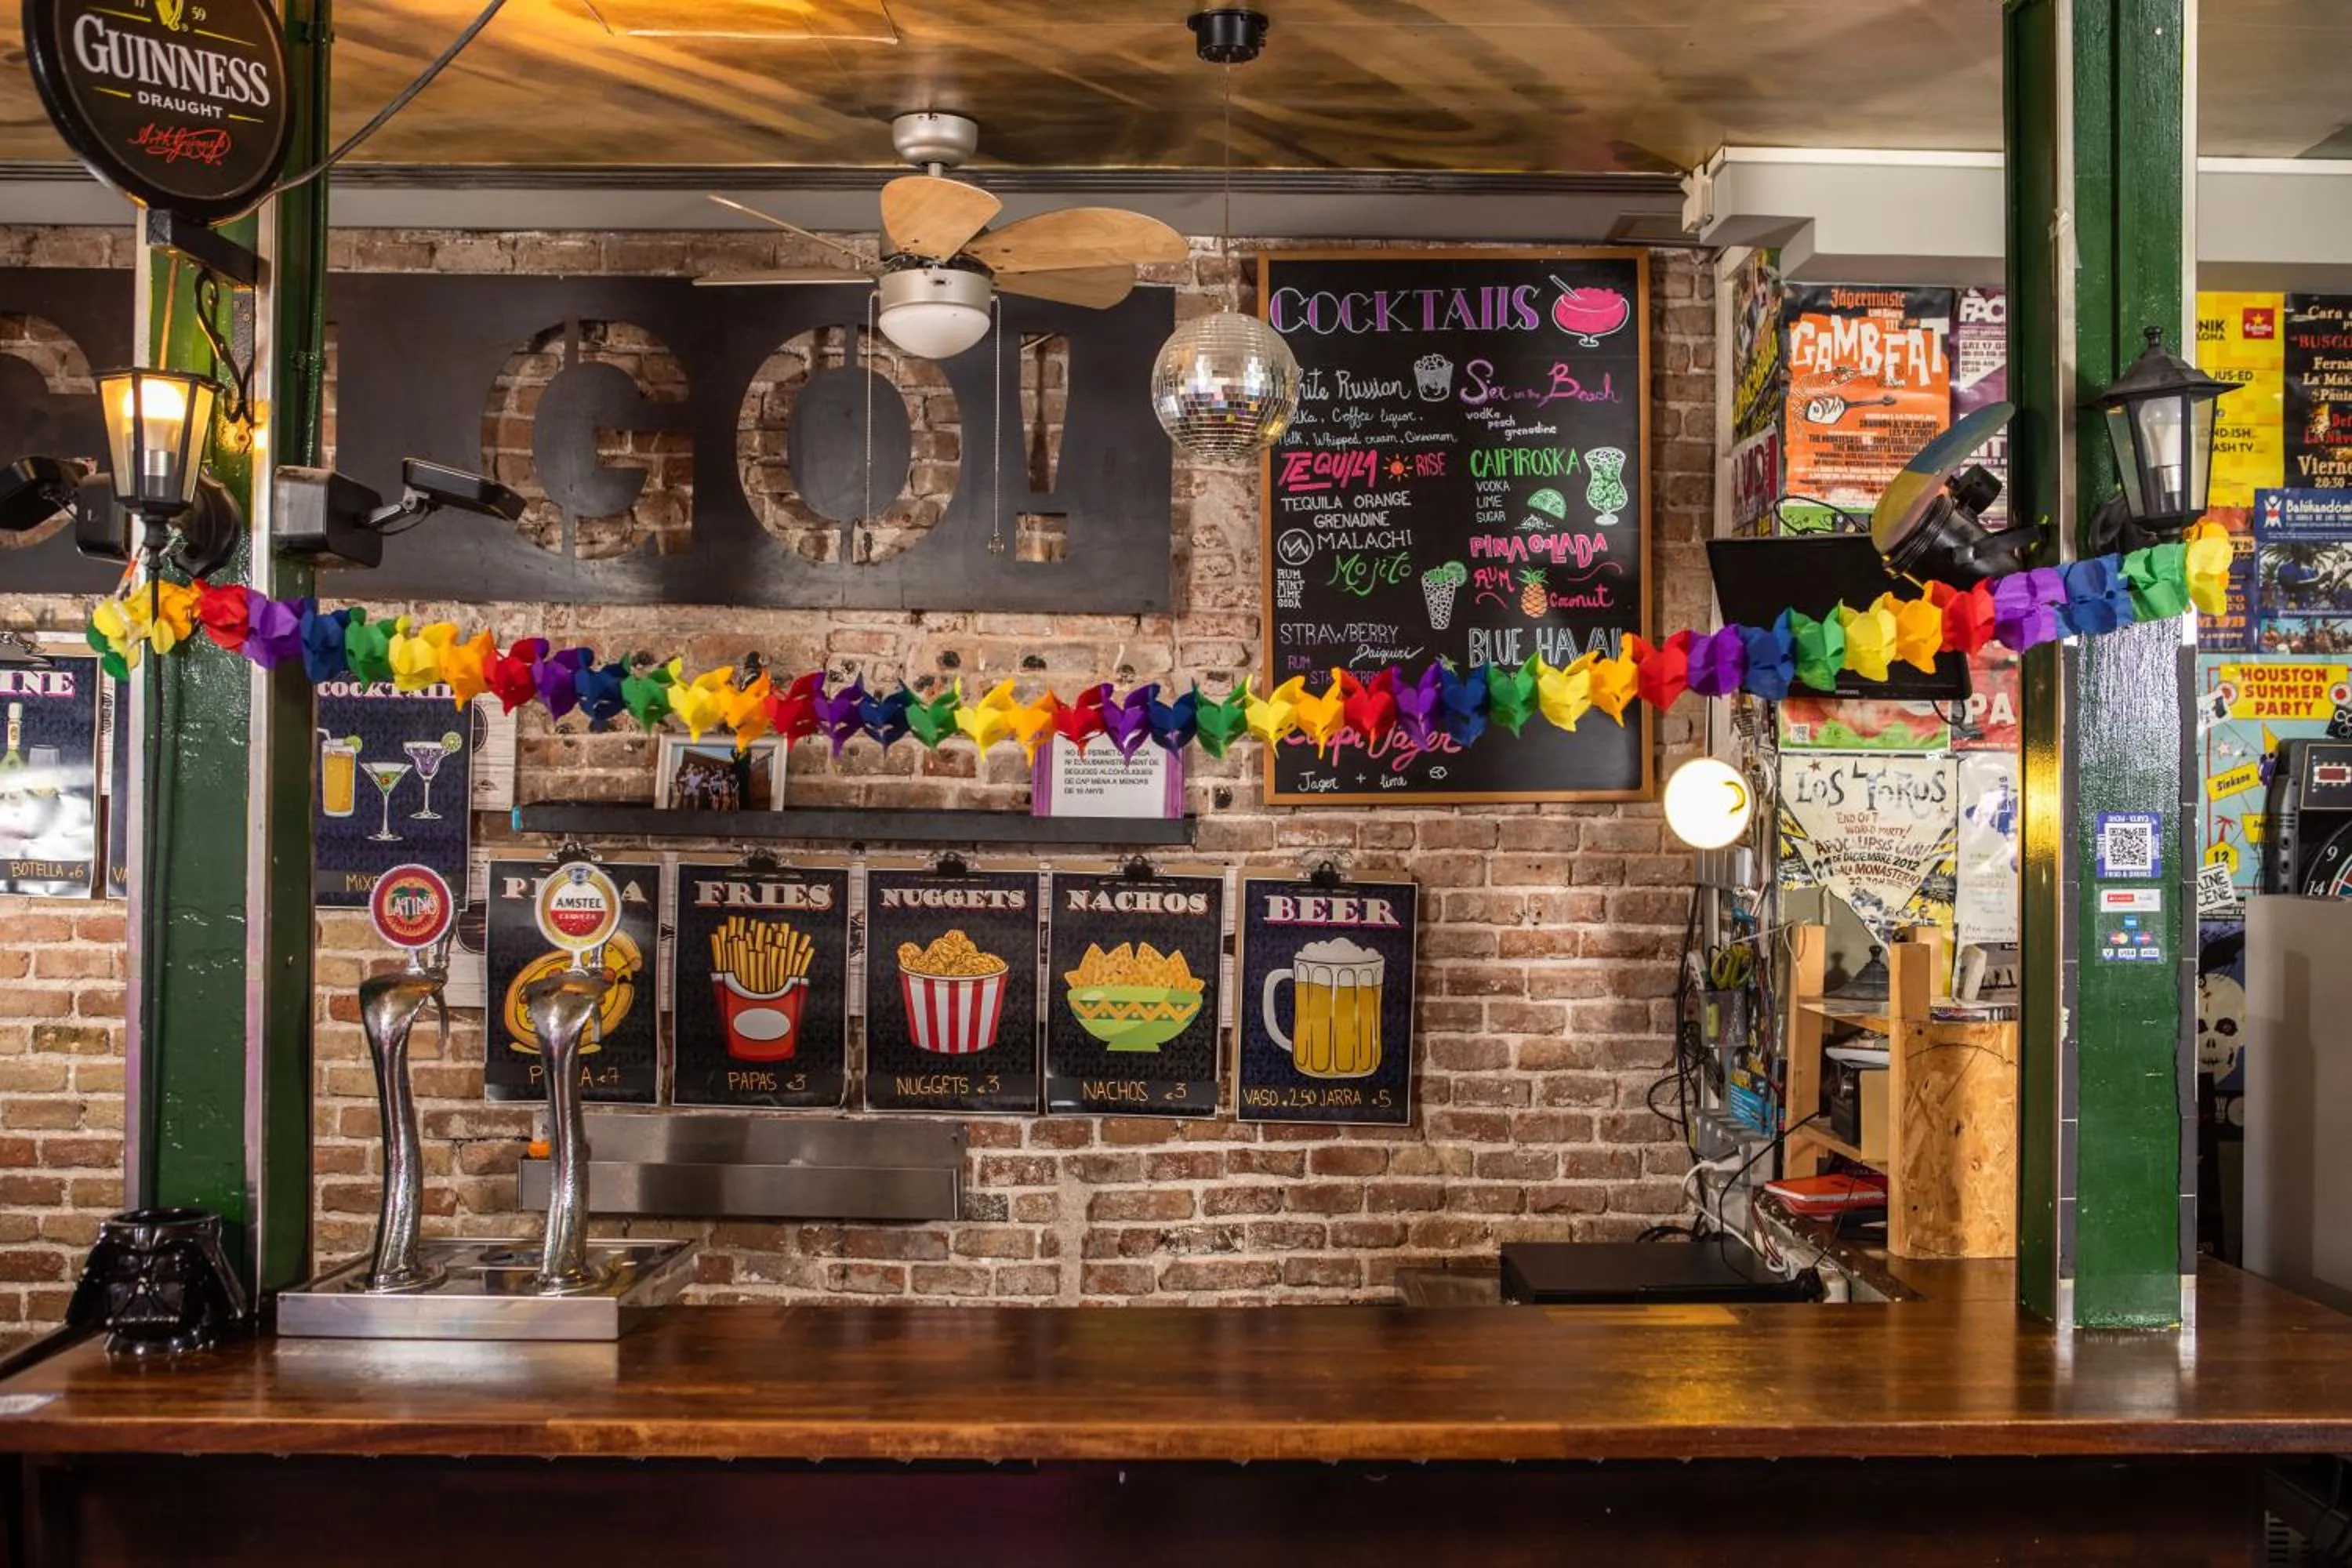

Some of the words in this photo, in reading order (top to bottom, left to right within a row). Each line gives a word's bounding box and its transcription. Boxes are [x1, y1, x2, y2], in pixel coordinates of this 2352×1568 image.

[191, 6, 206, 21] 59
[74, 14, 270, 107] GUINNESS
[137, 91, 223, 118] DRAUGHT
[1269, 285, 1541, 335] COCKTAILS
[1790, 314, 1950, 387] GAMBEAT
[1297, 368, 1330, 401] hite
[1335, 369, 1412, 401] Russian
[1460, 359, 1511, 405] Sex
[1537, 361, 1622, 408] Beach
[1332, 406, 1374, 428] Coffee
[1487, 416, 1515, 430] peach
[1312, 432, 1362, 451] Whipped
[1504, 421, 1557, 441] grenadine
[1278, 449, 1377, 488] TEQUILA
[1415, 452, 1447, 477] RISE
[1470, 447, 1582, 478] CAIPIROSKA
[1475, 481, 1511, 492] VODKA
[1280, 495, 1343, 512] TEQUILA
[1354, 490, 1412, 509] ORANGE
[1476, 495, 1503, 508] LIME
[1313, 510, 1390, 529] GRENADINE
[1475, 511, 1506, 524] SUGAR
[1317, 529, 1413, 550] MALACHI
[1276, 568, 1301, 579] RUM
[1325, 551, 1412, 597] Mojito
[1474, 567, 1515, 594] RUM
[1549, 583, 1614, 608] Coconut
[1279, 622, 1399, 646] STRAWBERRY
[1468, 627, 1525, 669] BLUE
[1535, 626, 1623, 666] HAAII
[1287, 655, 1311, 670] RUM
[2239, 667, 2328, 682] HOUSTON
[2245, 684, 2324, 699] SUMMER
[2254, 702, 2314, 717] PARTY
[1380, 773, 1408, 789] lime
[1892, 855, 1921, 872] 2012
[2326, 845, 2339, 862] 9
[12, 862, 64, 878] BOTELLA
[693, 880, 834, 910] FRIES
[879, 887, 1027, 910] NUGGETS
[2307, 880, 2326, 896] 14
[556, 898, 602, 909] AMSTEL
[1066, 889, 1210, 914] NACHOS
[1263, 895, 1403, 928] BEER
[728, 1071, 778, 1091] PAPAS
[895, 1075, 970, 1096] NUGGETS
[1082, 1081, 1149, 1103] NACHOS
[1243, 1089, 1279, 1106] VASO
[1319, 1088, 1363, 1107] JARRA
